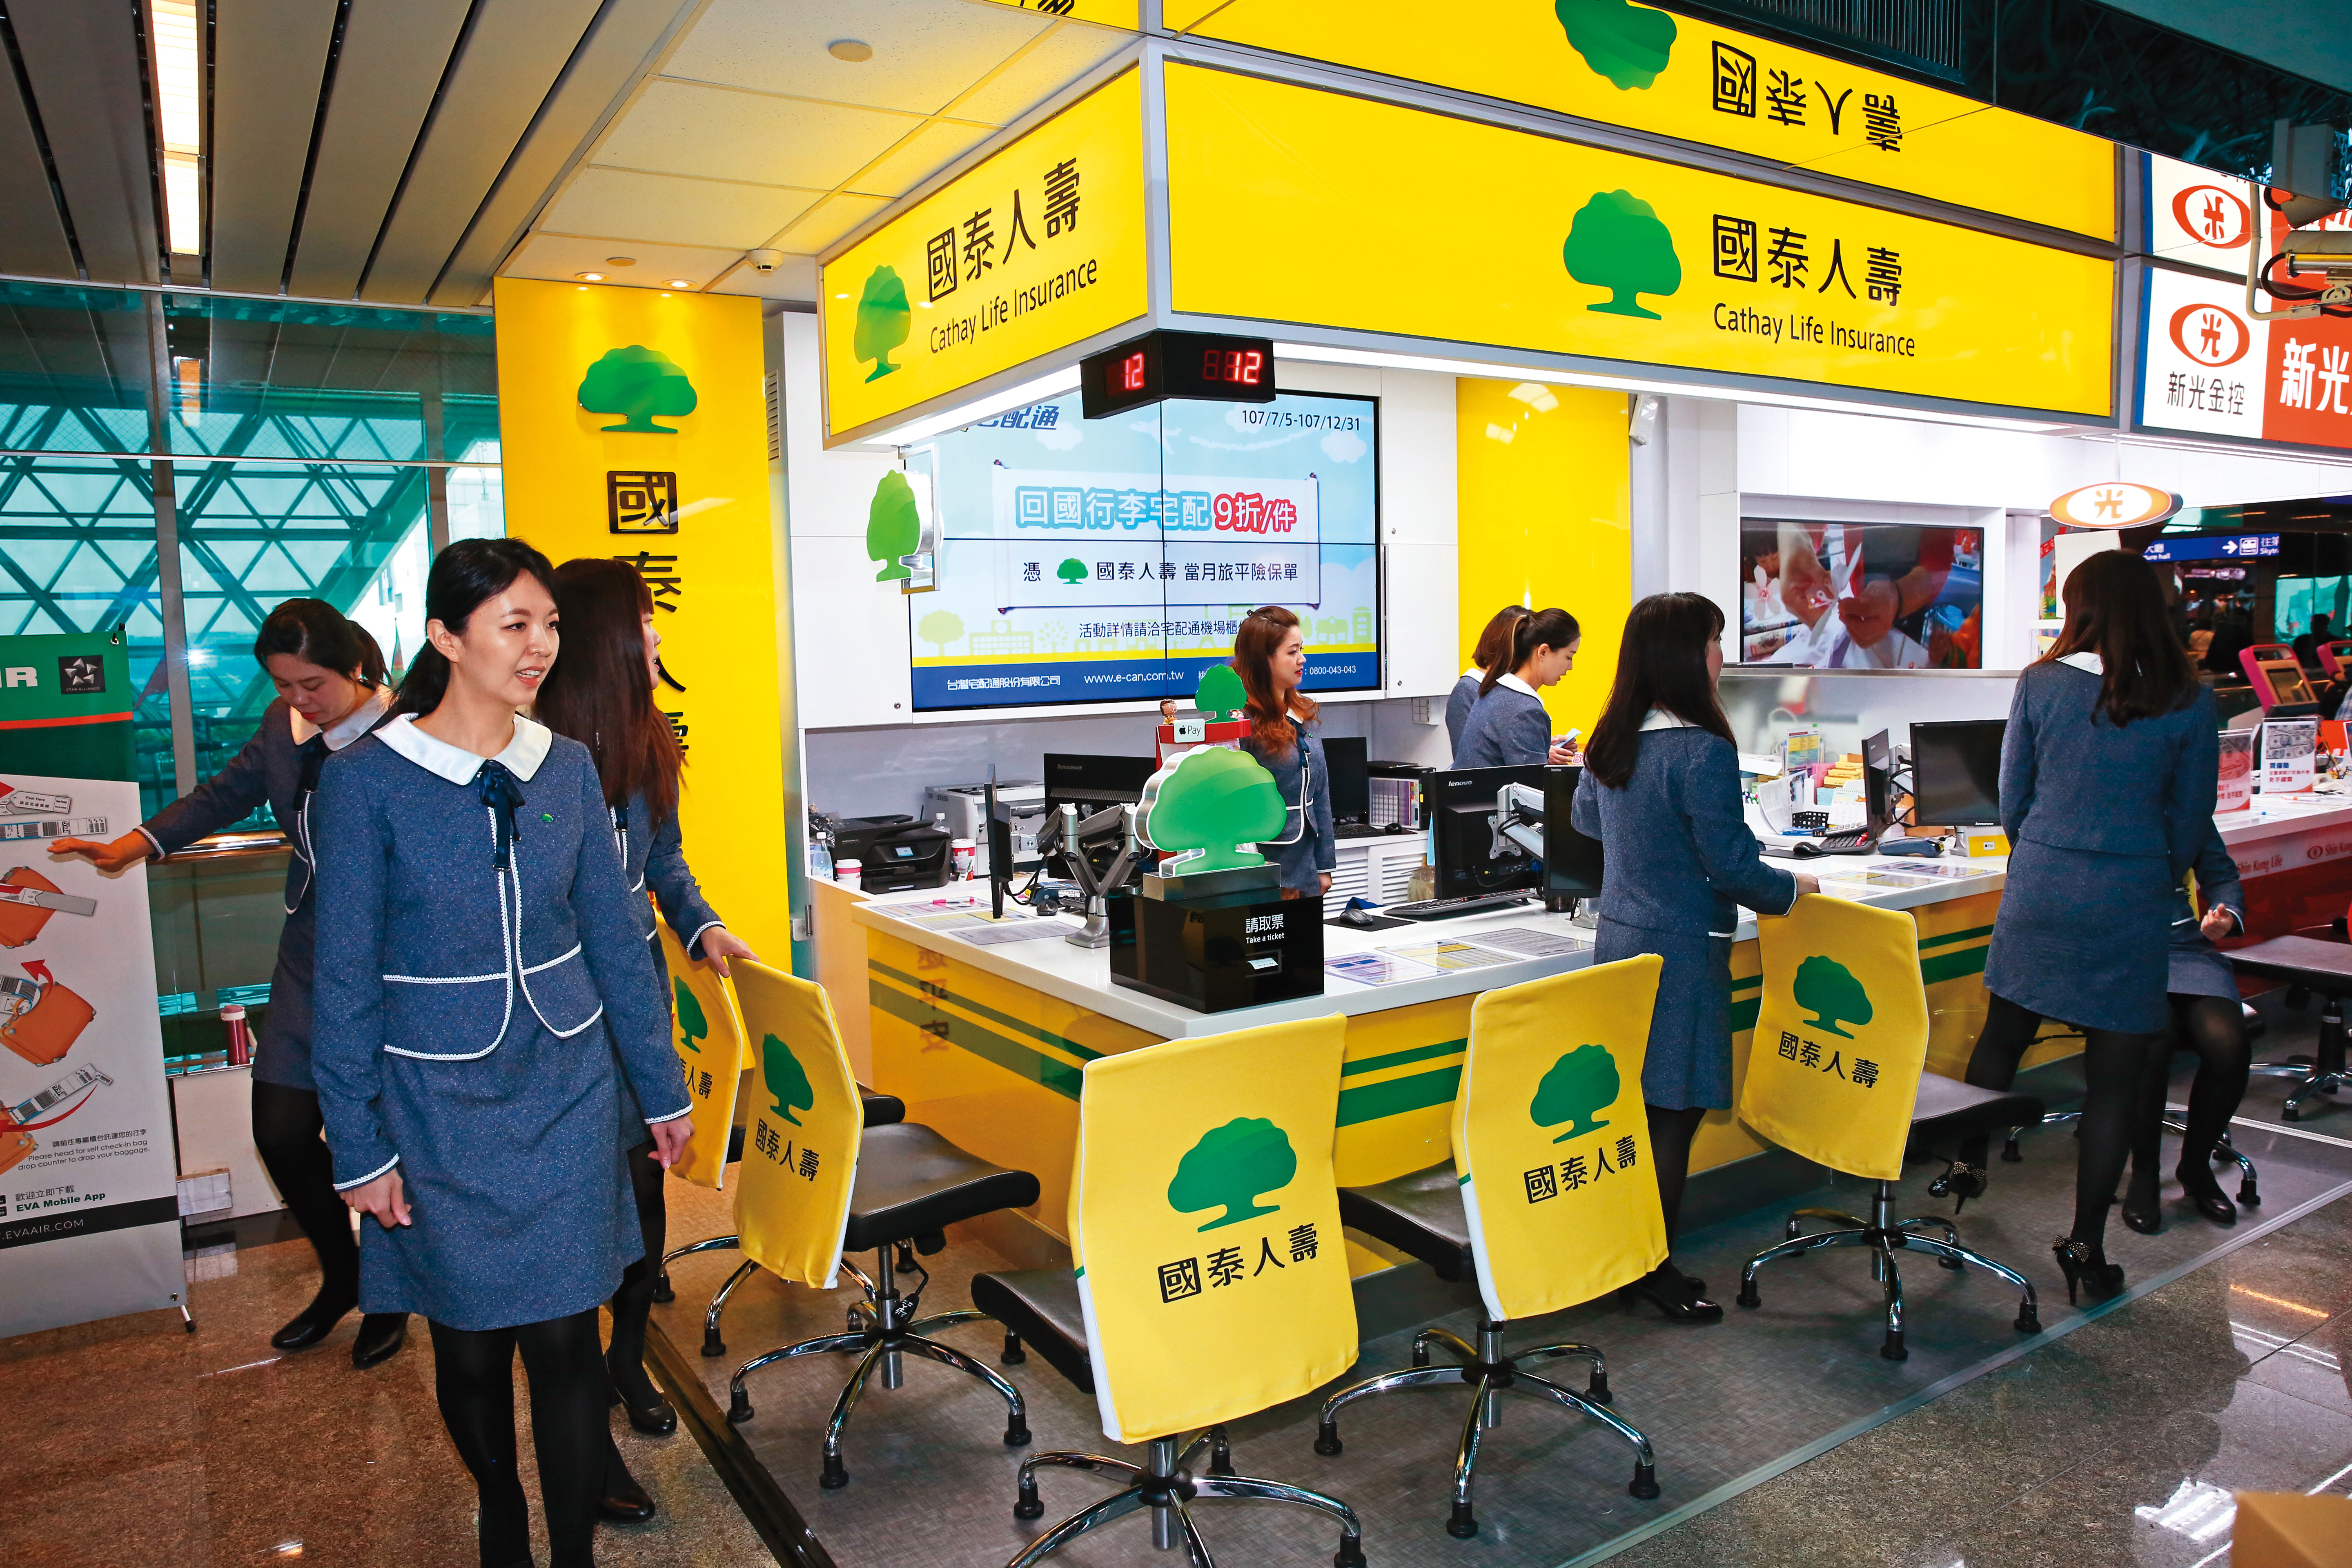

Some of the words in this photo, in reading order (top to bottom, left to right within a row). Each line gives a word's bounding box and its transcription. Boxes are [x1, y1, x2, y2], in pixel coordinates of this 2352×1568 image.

[927, 158, 1080, 303] 國泰人壽
[1713, 214, 1902, 306] 國泰人壽
[931, 314, 977, 354] Cathay
[982, 296, 1008, 332] Life
[1014, 258, 1098, 317] Insurance
[1714, 303, 1783, 343] Cathay
[1791, 314, 1823, 343] Life
[1831, 321, 1915, 357] Insurance
[1124, 352, 1144, 389] 12
[1234, 352, 1261, 383] 12
[2279, 337, 2352, 415] 新光
[2167, 371, 2245, 416] 新光金控
[1242, 410, 1360, 431] 107/7/5-107/12/31
[1018, 489, 1209, 529] 回國行李宅配
[1214, 492, 1297, 533] 9折/件
[1023, 561, 1042, 581] 憑
[1097, 561, 1176, 581] 國泰人壽
[1185, 562, 1298, 581] 當月旅平險保單
[1079, 620, 1244, 639] 活動詳情請洽宅配通機場櫃
[0, 667, 38, 688] R
[1084, 670, 1184, 684] www.e-can.com.tw
[1310, 665, 1356, 675] 0800-043-043
[947, 675, 1061, 691] 台灣宅配通股份有限公司
[1187, 725, 1201, 737] Pay
[1245, 914, 1284, 933] 請取票
[1246, 936, 1261, 944] Take
[1267, 932, 1285, 941] ticket
[1778, 1031, 1879, 1088] 國泰人壽
[18, 1163, 36, 1171] drop
[38, 1158, 67, 1167] counter
[114, 1147, 150, 1156] baggage.
[28, 1152, 52, 1161] Please
[54, 1149, 74, 1158] head
[100, 1142, 131, 1151] check-in
[755, 1118, 819, 1181] 國泰人壽
[1524, 1134, 1637, 1204] 國泰人壽
[15, 1185, 75, 1202] 歡迎立即下載
[16, 1202, 40, 1212] EVA
[43, 1196, 81, 1207] Mobile
[84, 1193, 106, 1202] App
[0, 1219, 84, 1240] .EVAAIR.COM
[1158, 1223, 1319, 1303] 國泰人壽
